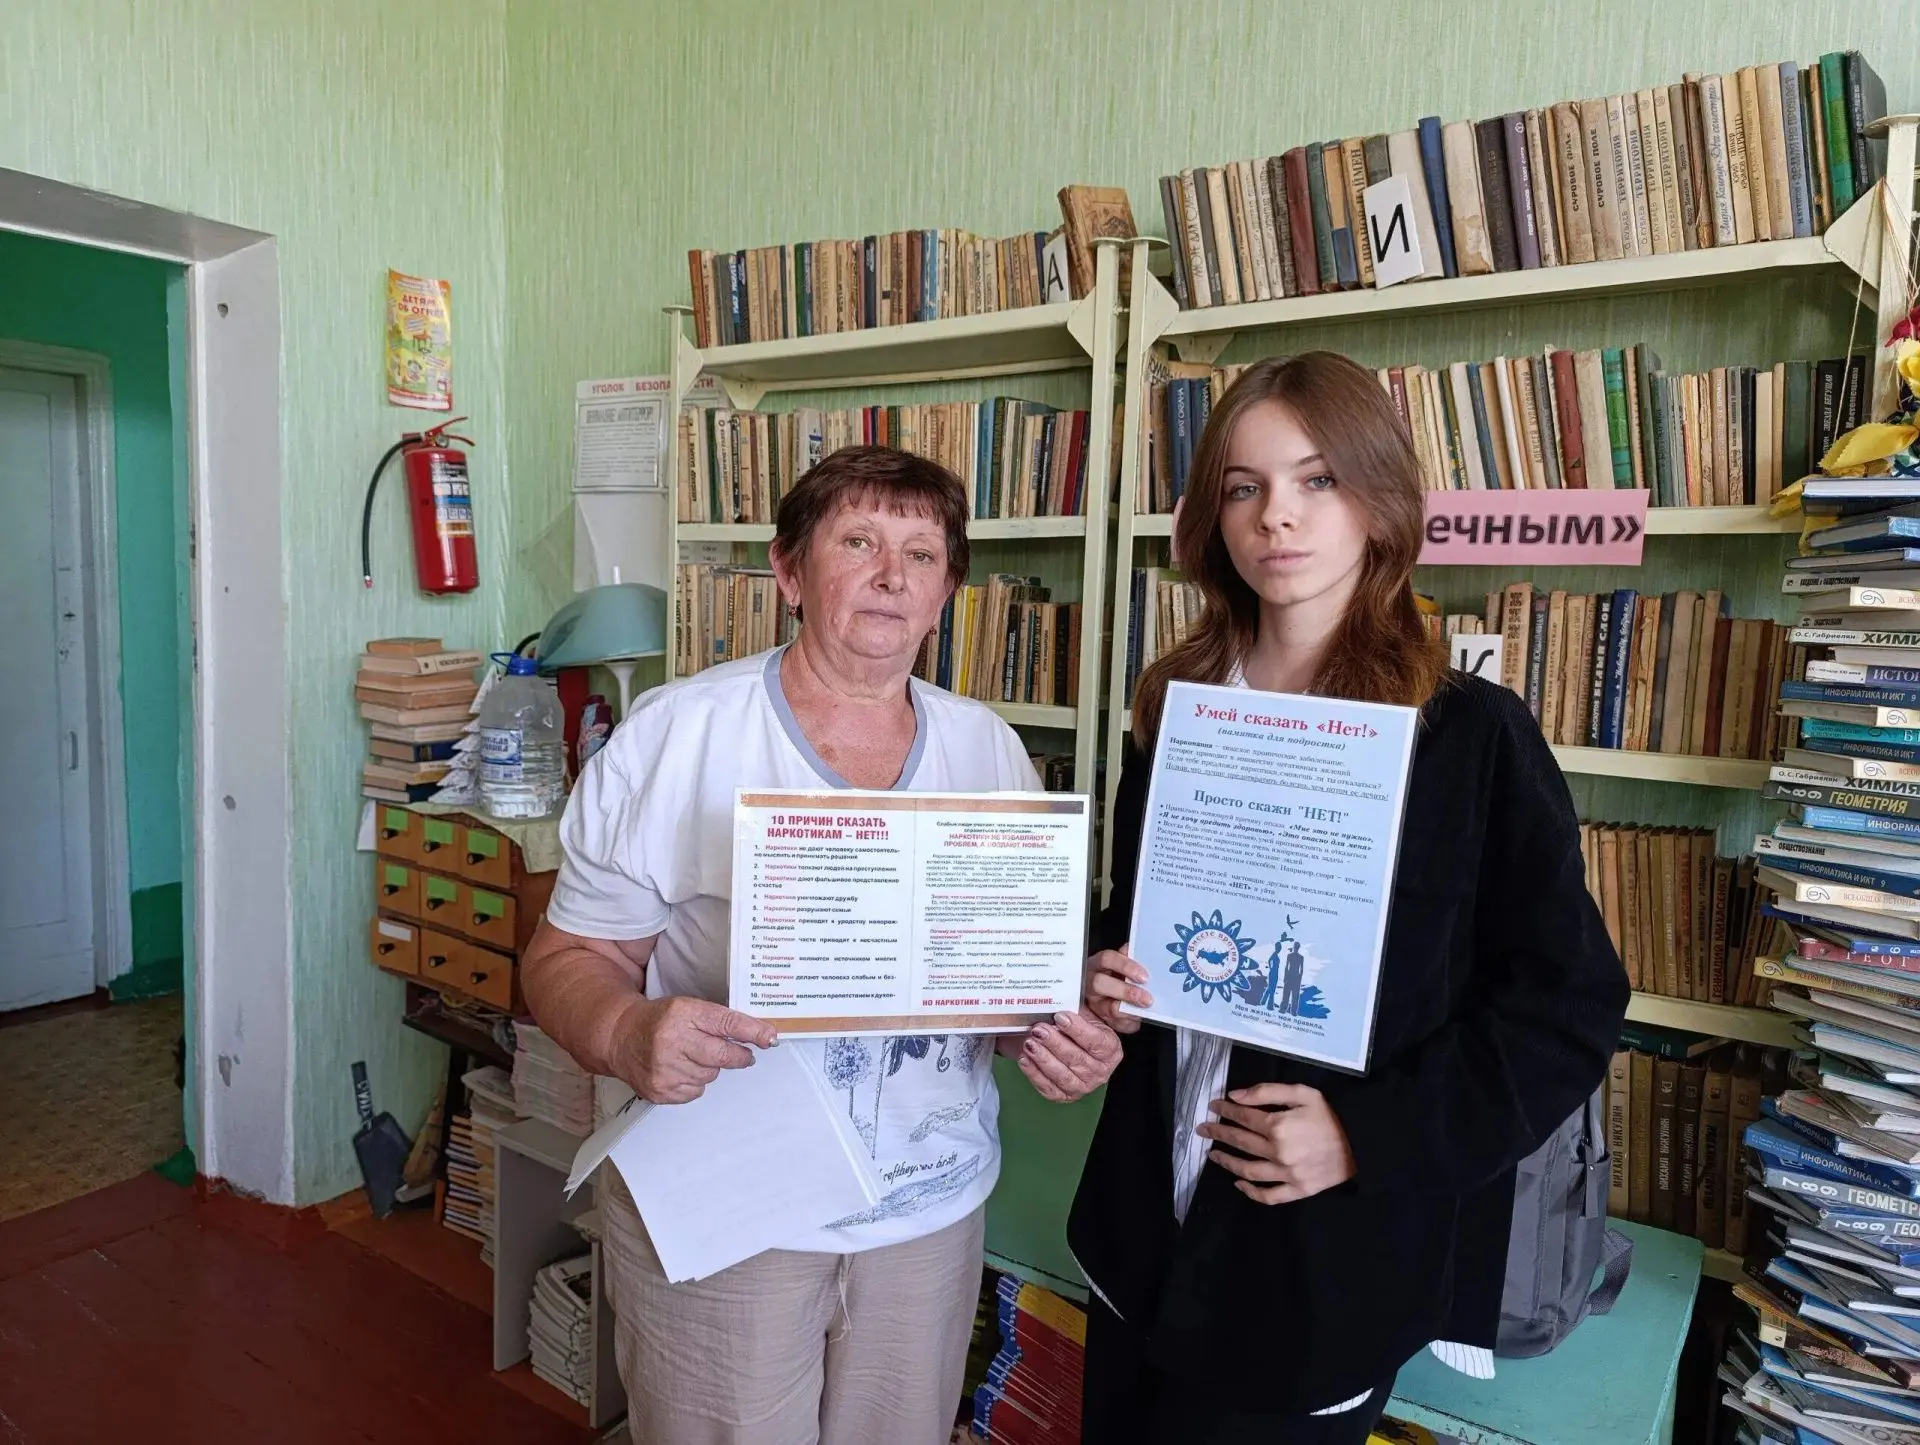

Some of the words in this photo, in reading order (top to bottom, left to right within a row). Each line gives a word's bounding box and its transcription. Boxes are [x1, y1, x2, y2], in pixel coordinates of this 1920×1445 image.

[1590, 128, 1600, 157] ПОЛЕ
[1643, 124, 1656, 193] ТЕРРИТОРИЯ
[1658, 120, 1672, 192] ТЕРРИТОРИЯ
[1612, 135, 1627, 203] ТЕРРИТОРИЯ
[1629, 129, 1644, 198] ТЕРРИТОРИЯ
[1567, 164, 1580, 212] СУРОВОЕ
[1593, 159, 1605, 208] СУРОВОЕ
[1371, 203, 1410, 263] И
[1047, 251, 1064, 302] А
[592, 383, 624, 394] УГОЛОК
[1426, 514, 1640, 545] ечным»
[1599, 602, 1610, 641] СЛОН
[1594, 644, 1606, 697] БЕЛЫЙ
[1825, 688, 1880, 700] ИНФОРМАТИКА
[1881, 691, 1888, 700] И
[1888, 692, 1906, 701] ИКТ
[1195, 703, 1238, 722] Умей
[1243, 713, 1308, 731] сказать
[1316, 719, 1378, 738] «Нет!»
[1217, 727, 1265, 740] (памятка
[1267, 732, 1285, 743] для
[1287, 736, 1346, 751] подростка)
[1842, 742, 1893, 756] ИНФОРМАТИКА
[1844, 776, 1920, 795] ХИМИЯ
[1194, 789, 1243, 808] Просто
[1248, 801, 1292, 816] скажи
[1298, 805, 1349, 824] "НЕТ!"
[1828, 791, 1908, 814] ГЕОМЕТРИЯ
[767, 828, 843, 839] НАРКОТИКАМ
[855, 830, 889, 840] НЕТ!!!
[771, 815, 785, 825] 10
[788, 815, 833, 826] ПРИЧИН
[836, 816, 887, 828] СКАЗАТЬ
[1867, 819, 1920, 833] ИНФОРМА
[1799, 862, 1853, 881] ИНФОРМАТИКА
[1860, 874, 1876, 886] ИКТ
[1880, 880, 1886, 888] 9
[1846, 950, 1920, 968] ГЕОГ
[988, 998, 1003, 1006] ЭТО
[1612, 1105, 1624, 1147] НИКУЛИН
[1660, 1118, 1670, 1155] НИКУЛИН
[1612, 1150, 1624, 1188] МИХАИЛ
[1660, 1156, 1669, 1191] МИХАИЛ
[1801, 1151, 1872, 1182] ИНФОРМАТИКА
[1893, 1222, 1920, 1237] ГЕО
